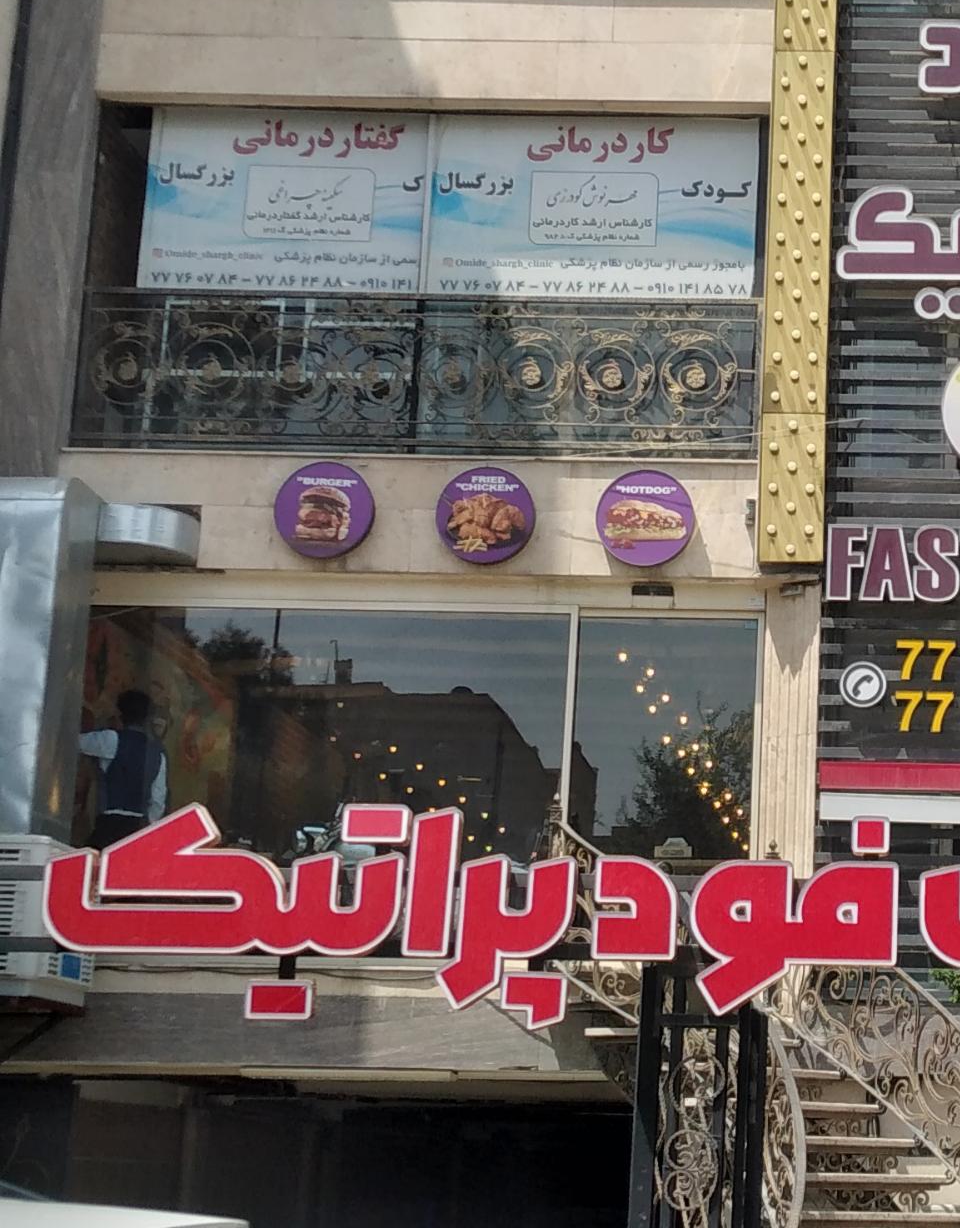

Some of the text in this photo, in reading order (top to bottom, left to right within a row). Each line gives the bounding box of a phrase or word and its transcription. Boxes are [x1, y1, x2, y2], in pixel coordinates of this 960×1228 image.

[681, 180, 753, 203] کودک
[393, 257, 417, 266] سمی
[560, 257, 597, 270] پزشکی
[471, 475, 506, 484] FRIED
[896, 639, 957, 682] 77
[895, 690, 955, 733] 77
[43, 801, 579, 1030] پراتیک
[591, 815, 900, 1017] فود
